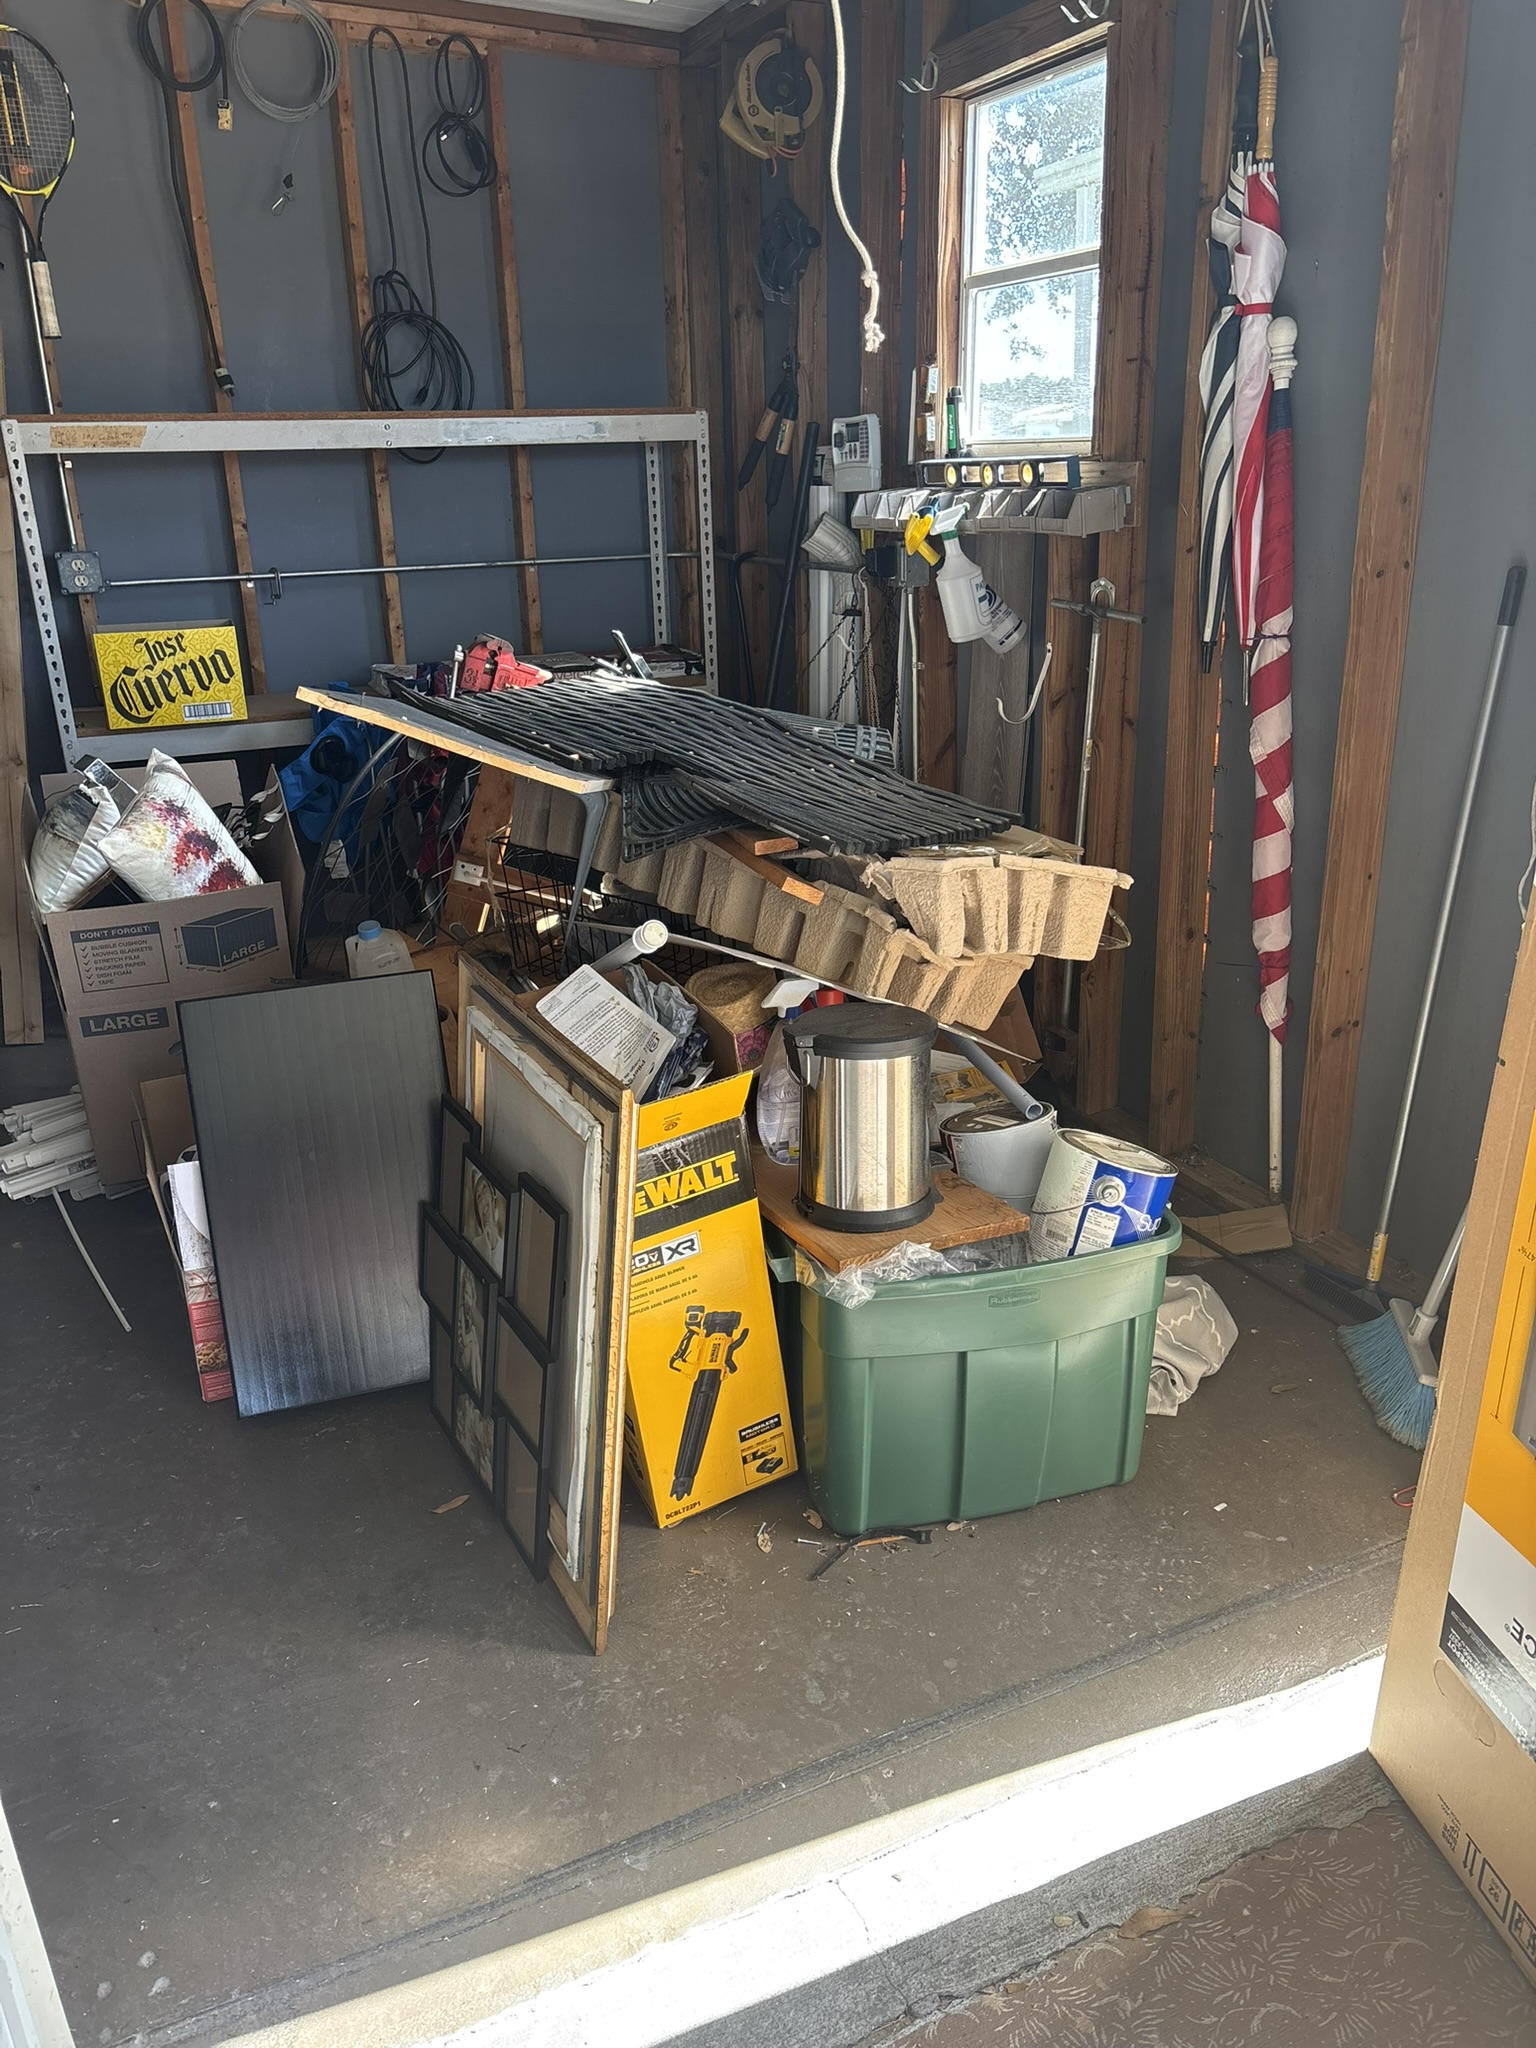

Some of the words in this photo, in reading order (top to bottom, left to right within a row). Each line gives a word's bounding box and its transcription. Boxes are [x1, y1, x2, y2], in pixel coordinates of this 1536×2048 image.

[134, 632, 187, 668] Jose
[110, 649, 235, 724] Cuervo
[80, 930, 109, 940] DON'T
[111, 925, 152, 936] FORGET:
[90, 943, 117, 951] BUBBLE
[118, 940, 147, 949] CUSHION
[92, 950, 118, 958] MOVING
[119, 946, 153, 955] BLANKETS
[223, 939, 266, 963] LARGE
[94, 957, 124, 965] STRETCH
[95, 964, 124, 972] PACKING
[124, 961, 146, 969] PAPER
[89, 1012, 160, 1033] LARGE
[634, 1154, 737, 1213] EWALT
[664, 1238, 697, 1261] XR
[665, 1501, 701, 1520] DCBL722P1
